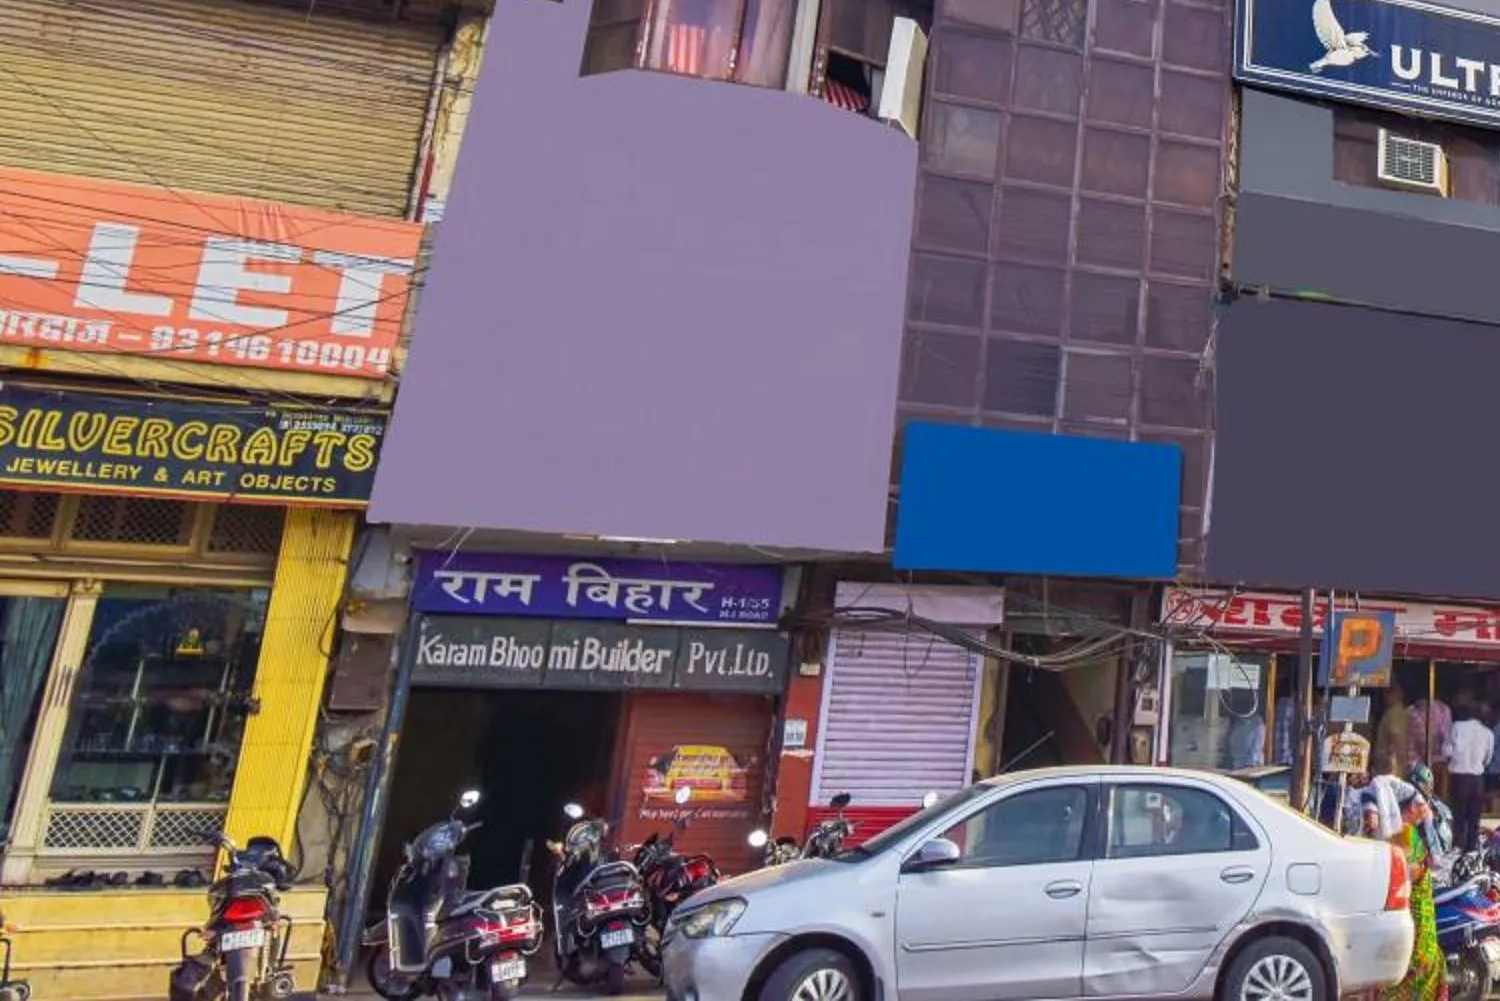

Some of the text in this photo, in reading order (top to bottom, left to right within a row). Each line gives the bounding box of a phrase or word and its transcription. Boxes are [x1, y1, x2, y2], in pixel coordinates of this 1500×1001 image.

[6, 456, 337, 494] JEWELLERY & ART OBJECTS
[433, 562, 715, 615] राम बिहार
[416, 632, 486, 667] Karam
[581, 637, 673, 675] Builder
[1335, 617, 1382, 679] P
